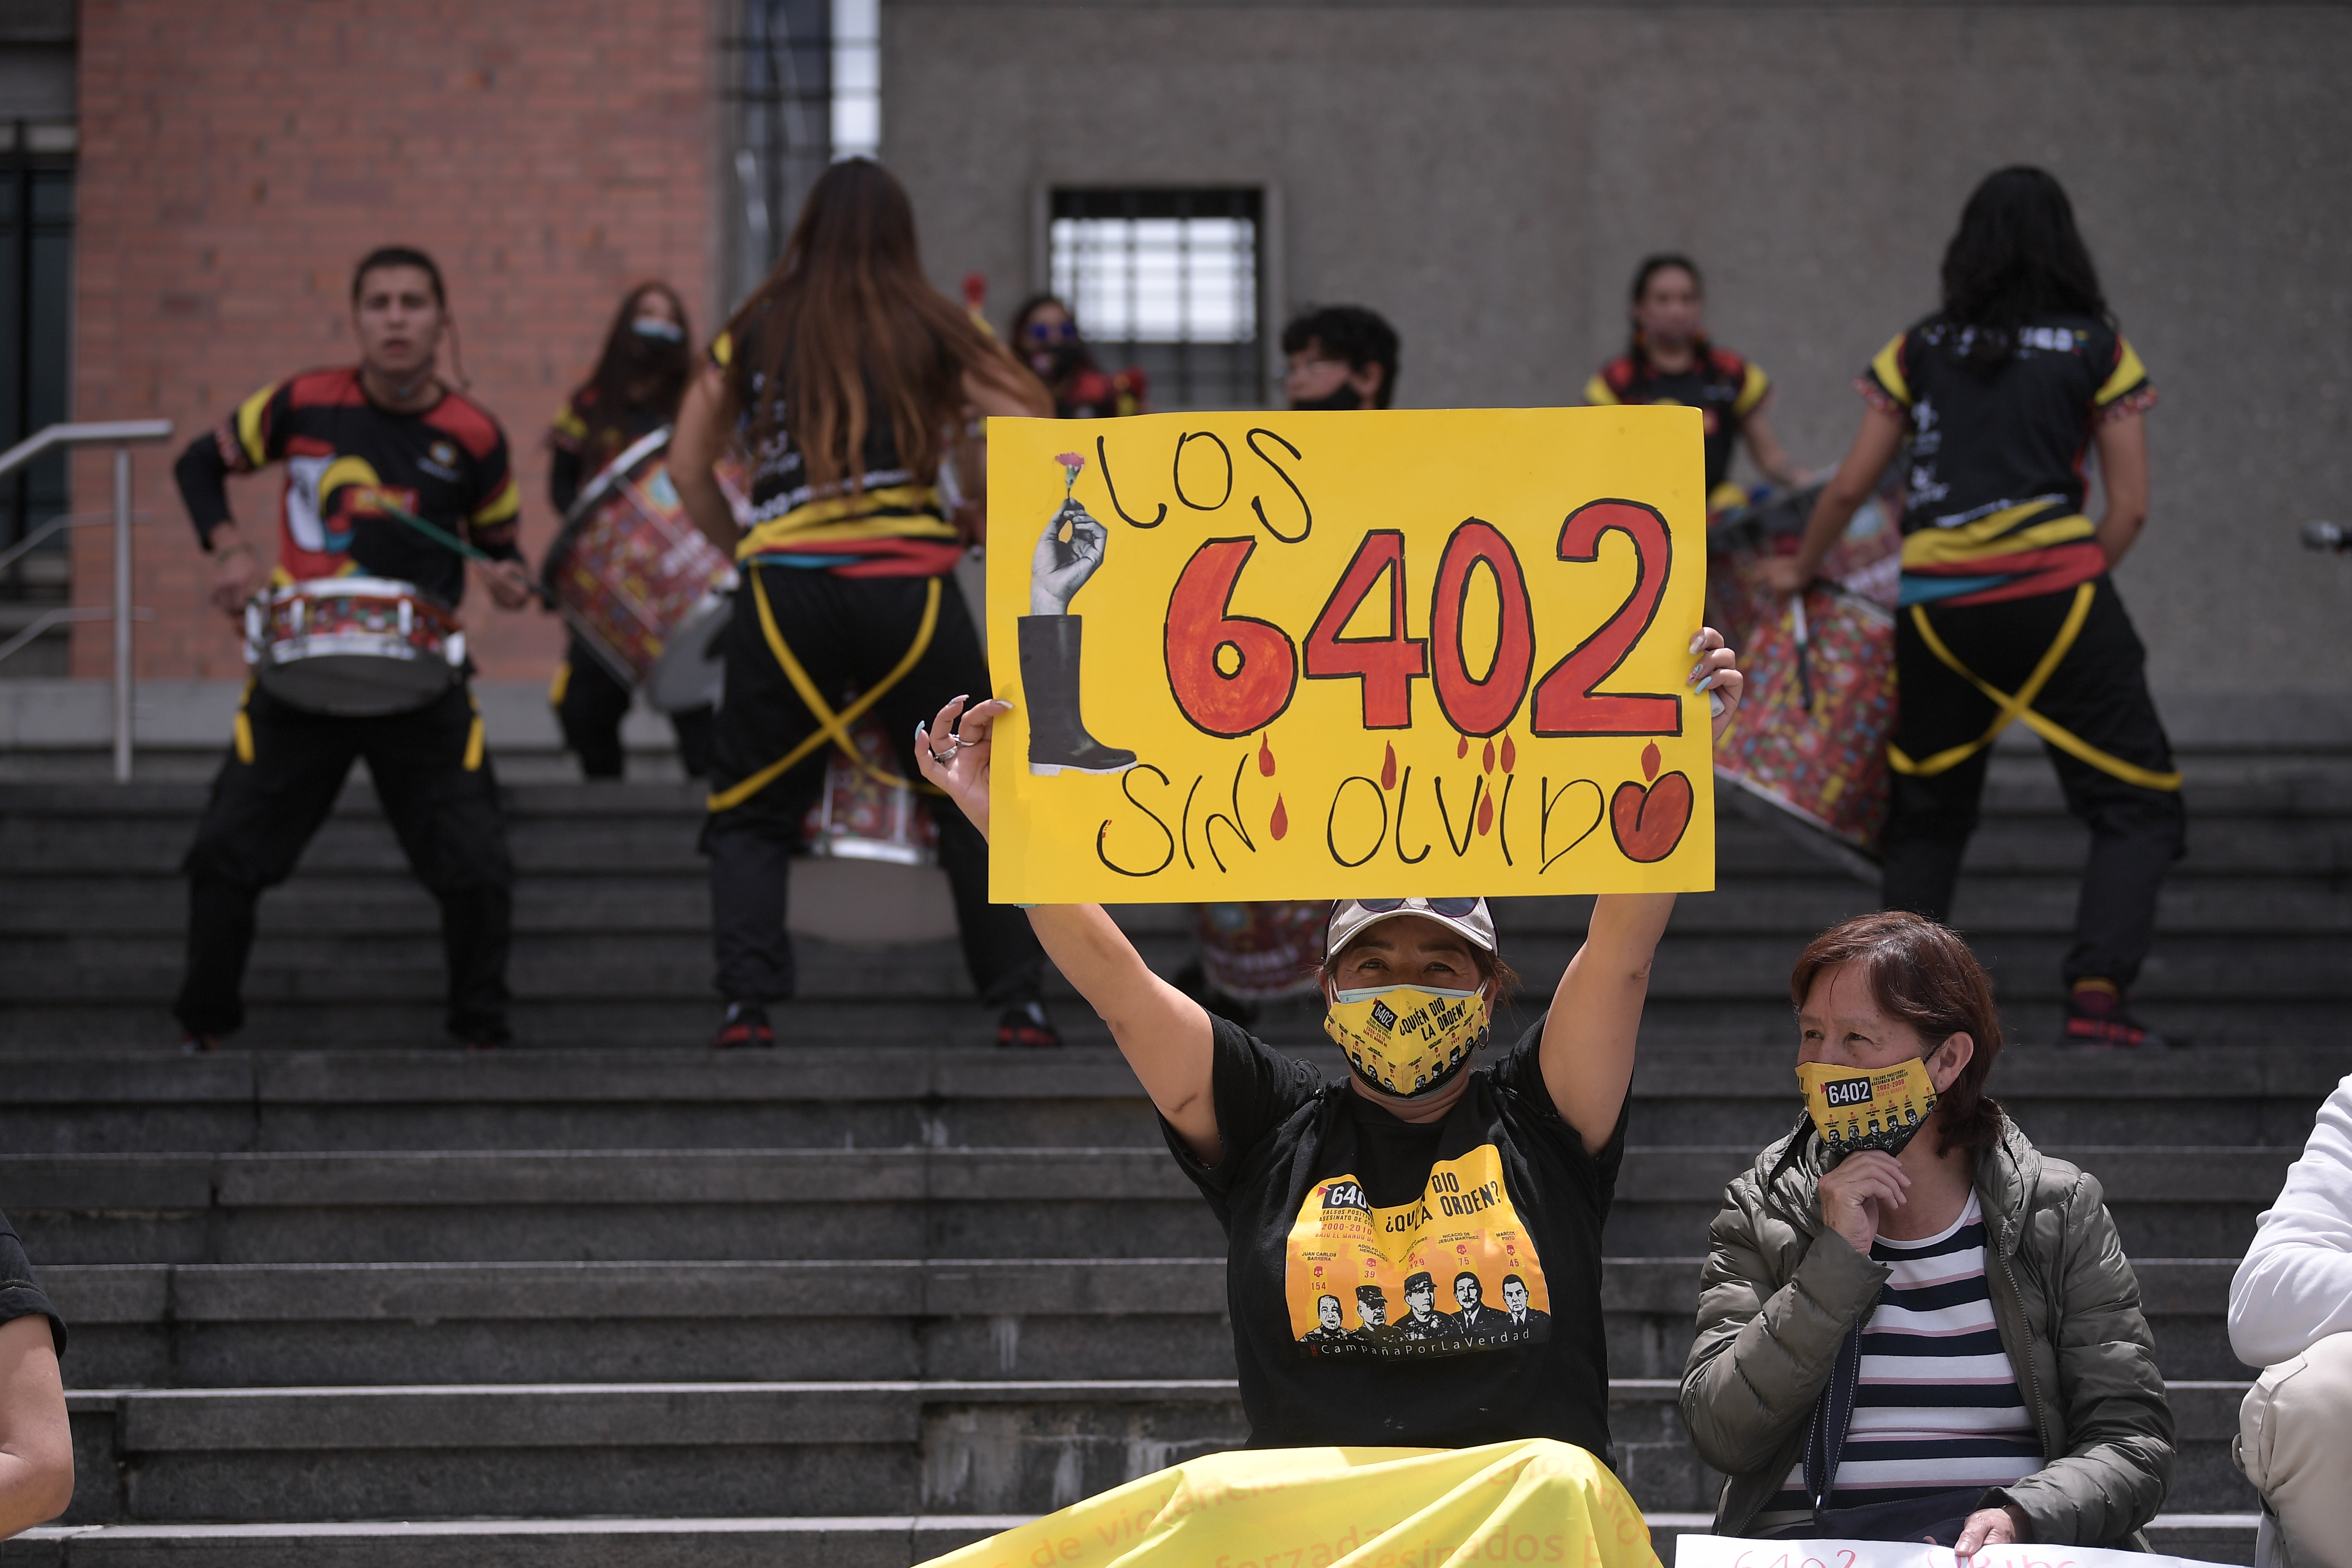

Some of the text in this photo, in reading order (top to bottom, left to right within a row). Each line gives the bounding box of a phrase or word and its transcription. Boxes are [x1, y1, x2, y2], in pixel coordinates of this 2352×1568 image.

[1097, 428, 1312, 544] LOS
[1163, 497, 1682, 739] 6402
[1096, 753, 1256, 876] SIN
[1375, 1004, 1394, 1027] 6402
[1421, 1023, 1436, 1041] LA
[1437, 999, 1466, 1031] ORDEN?
[1828, 1081, 1870, 1104] 6402
[1876, 1078, 1905, 1091] 2002-2008
[1431, 1172, 1460, 1194] DIO
[1440, 1180, 1501, 1217] ORDEN?
[1347, 1209, 1373, 1224] POSITIV
[1322, 1222, 1372, 1235] 2000-2010
[1357, 1244, 1378, 1252] ADOLFO
[1458, 1257, 1470, 1266] 75
[1509, 1258, 1519, 1268] 45
[1364, 1270, 1375, 1278] 39
[1311, 1282, 1326, 1290] 154
[1309, 1328, 1530, 1357] #CampañaPorLaVerdad
